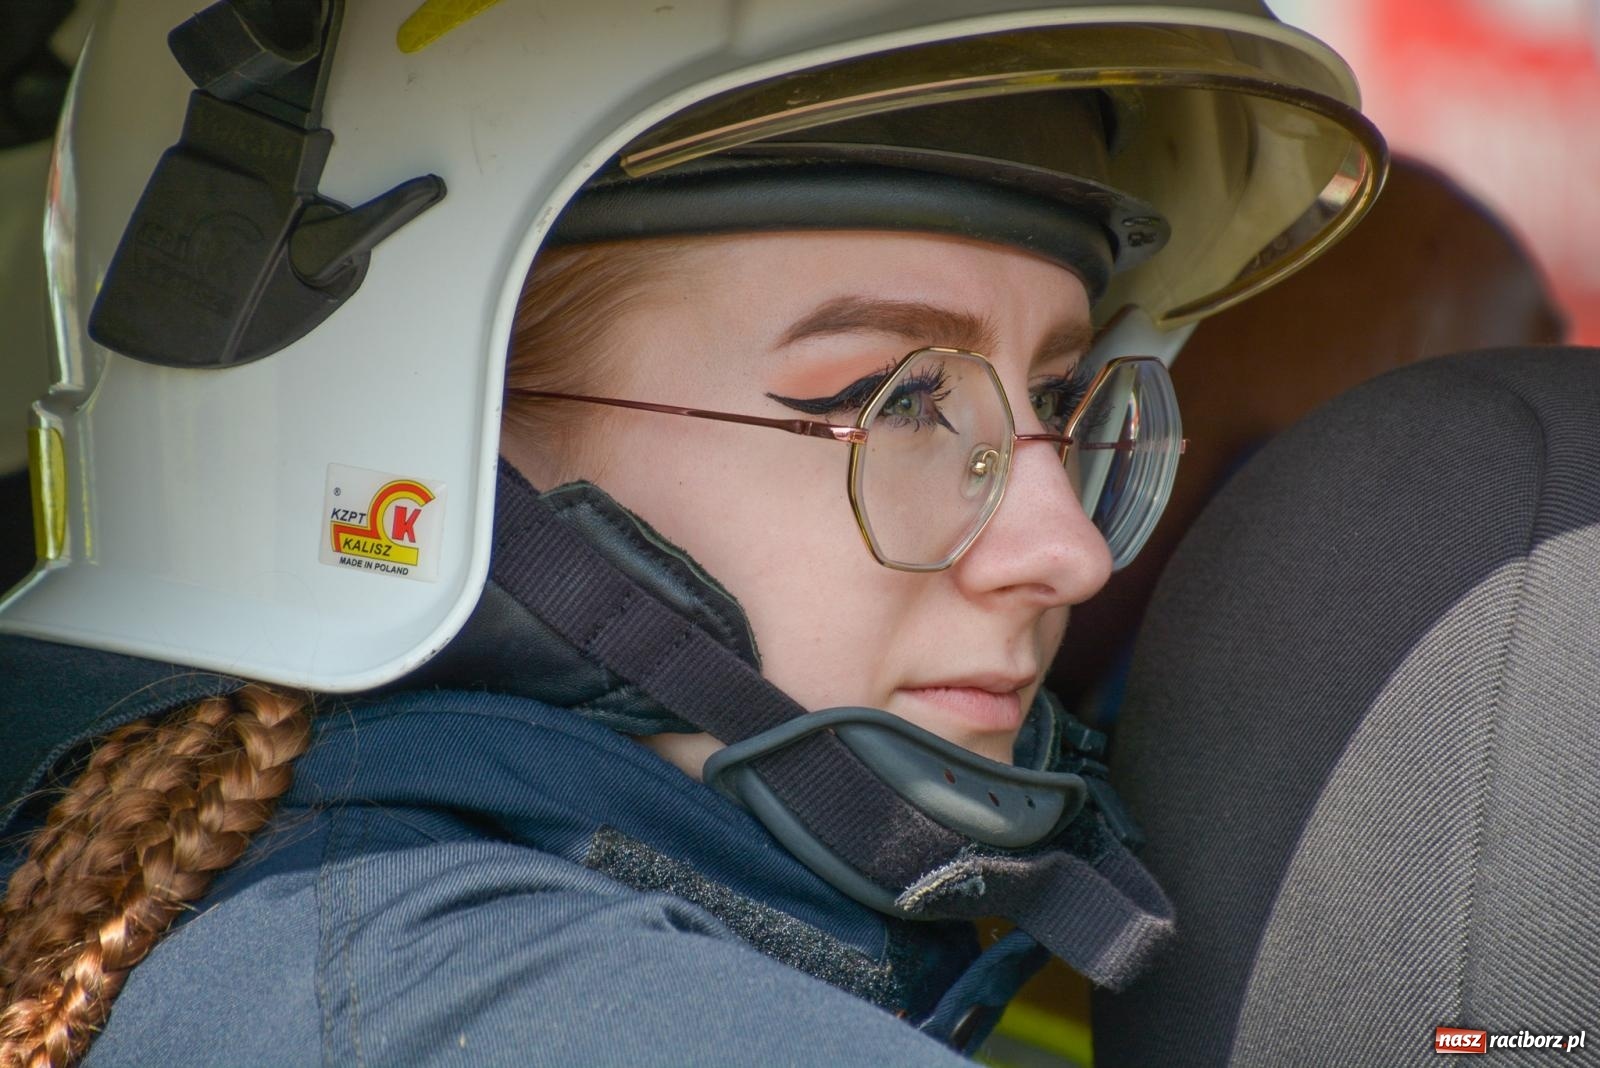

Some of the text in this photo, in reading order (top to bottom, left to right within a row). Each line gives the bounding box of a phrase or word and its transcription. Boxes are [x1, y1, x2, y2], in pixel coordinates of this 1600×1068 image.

[331, 508, 366, 524] KZPT
[392, 506, 422, 543] K
[343, 537, 392, 557] KALISZ
[340, 556, 409, 576] MADE IN POLAND
